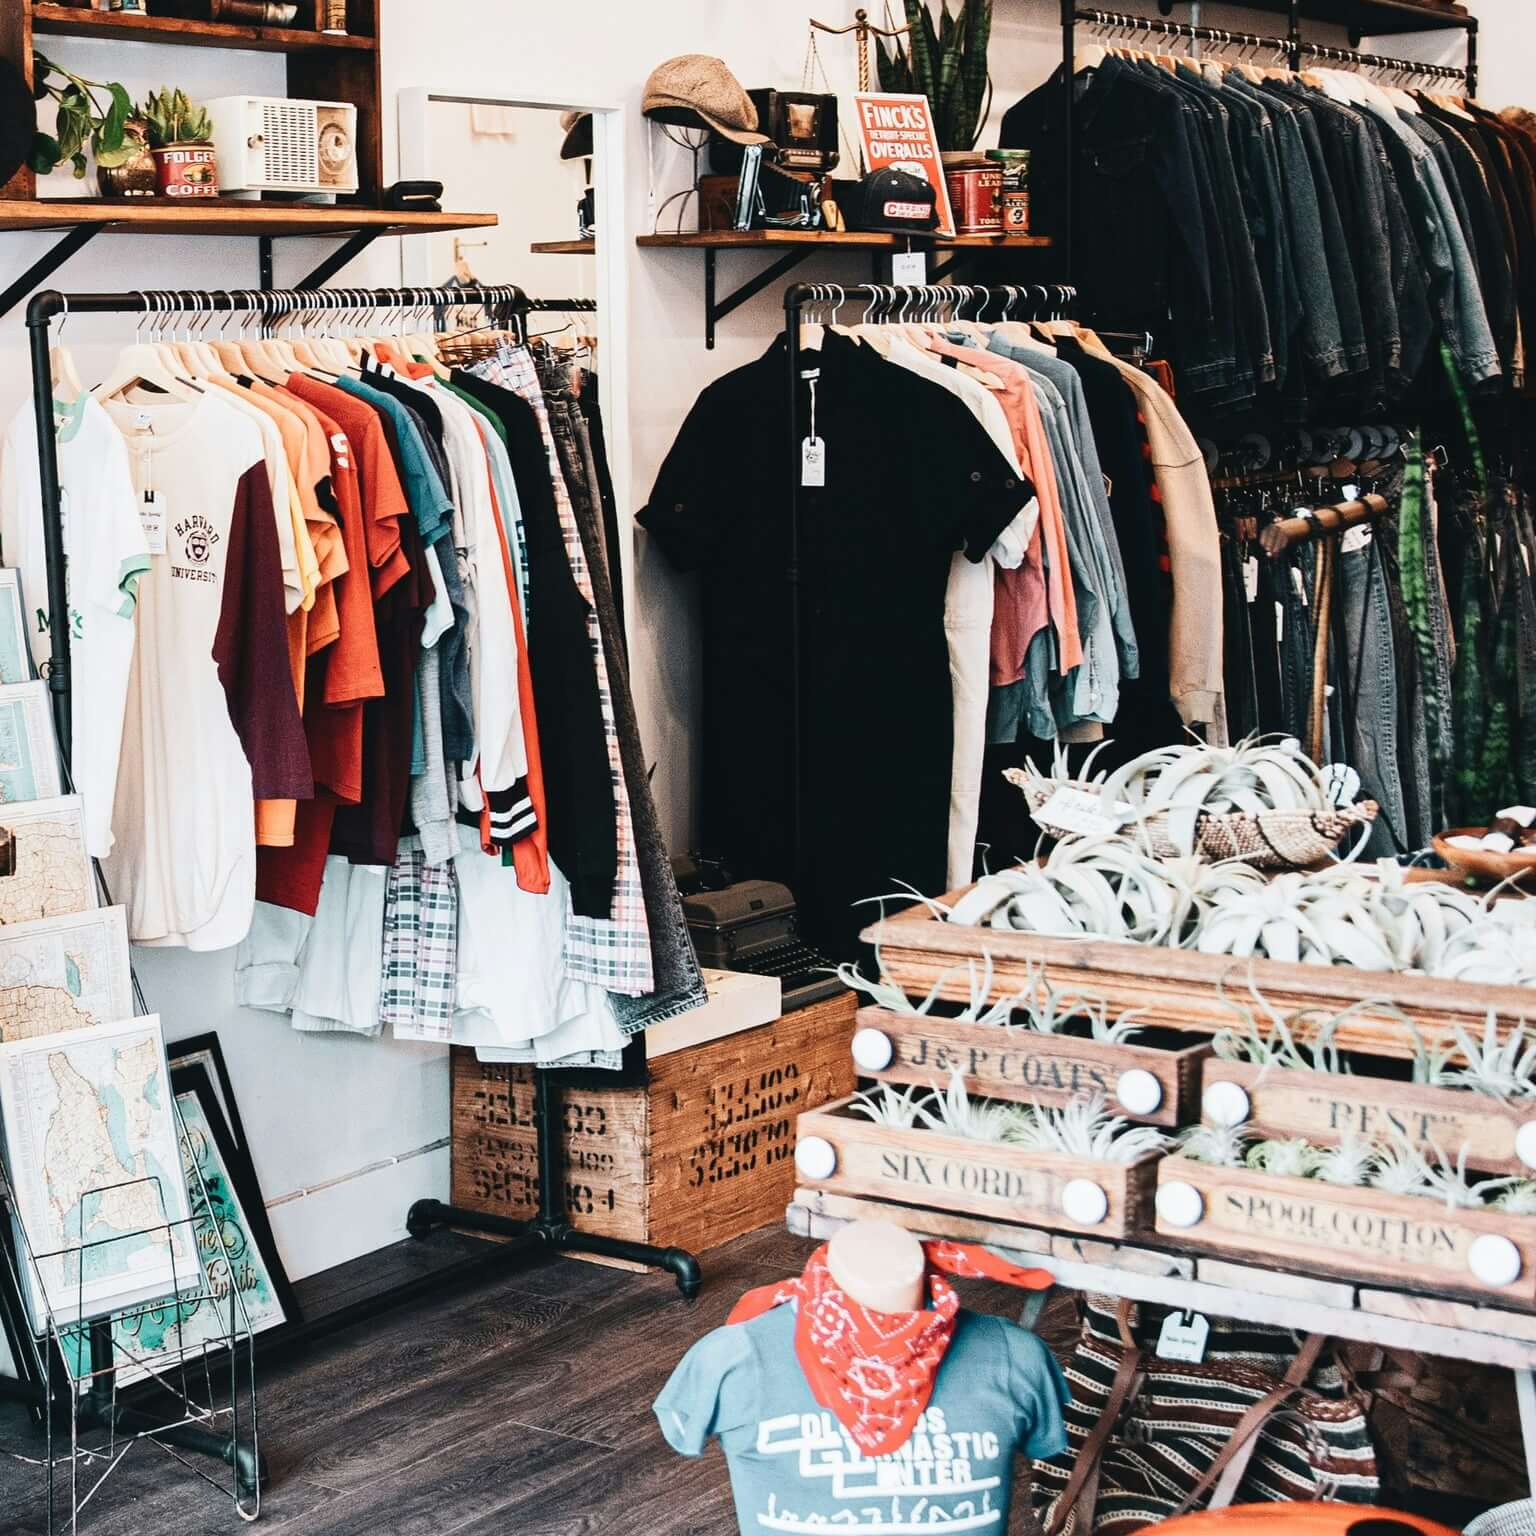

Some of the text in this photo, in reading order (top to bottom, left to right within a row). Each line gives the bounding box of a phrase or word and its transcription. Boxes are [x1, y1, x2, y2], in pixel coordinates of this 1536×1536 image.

[862, 101, 926, 129] FINCK'S
[870, 142, 934, 160] OVERALLS
[174, 515, 221, 544] HARVARD
[998, 1054, 1110, 1095] COATS
[473, 1091, 607, 1136] COFEE
[882, 1152, 1027, 1198] SIX CORD
[1226, 1194, 1317, 1228] SPOOL
[1332, 1209, 1457, 1252] COTTON
